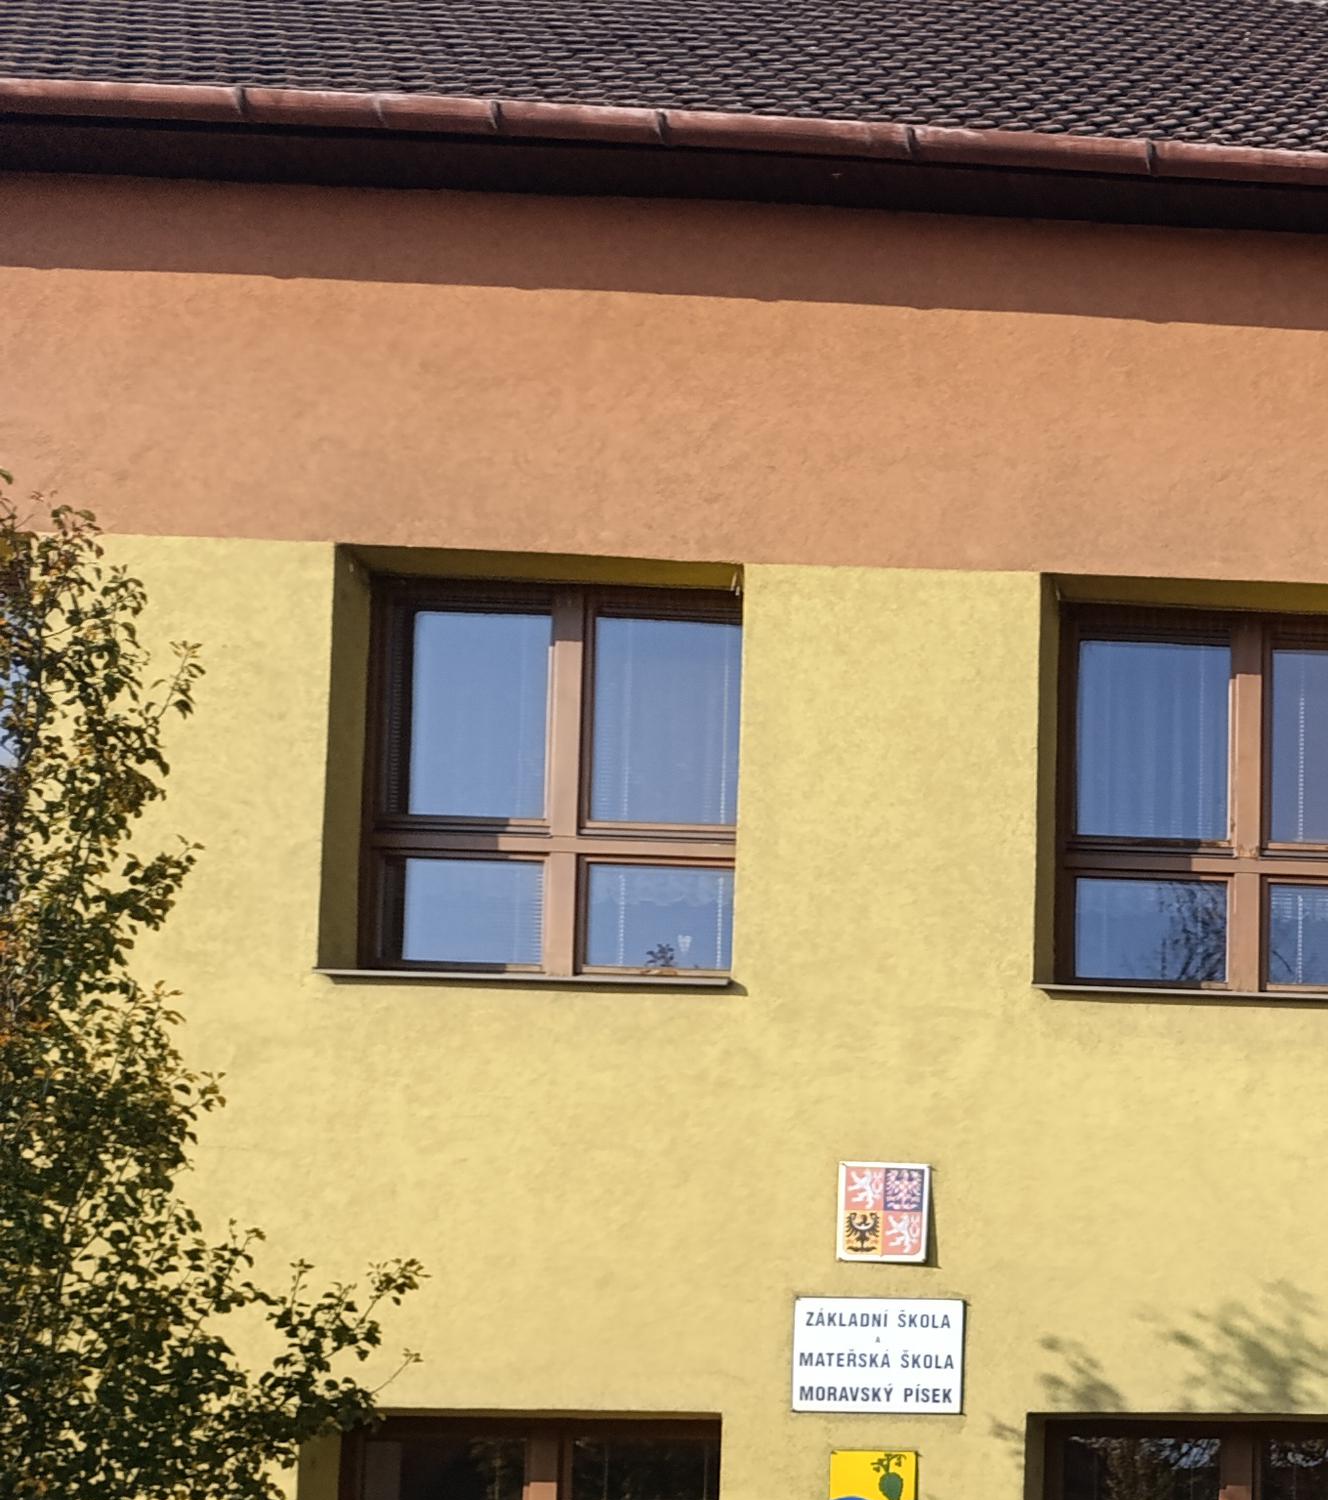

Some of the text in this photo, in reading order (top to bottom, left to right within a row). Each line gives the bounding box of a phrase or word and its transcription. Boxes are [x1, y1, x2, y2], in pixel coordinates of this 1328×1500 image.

[805, 1307, 951, 1330] ZÁKLADNÍ ŠKOLA
[875, 1336, 881, 1344] A
[799, 1348, 955, 1370] MATEŘSKÁ ŠKOLA
[799, 1383, 953, 1404] MORAVSKÝ PÍSEK
